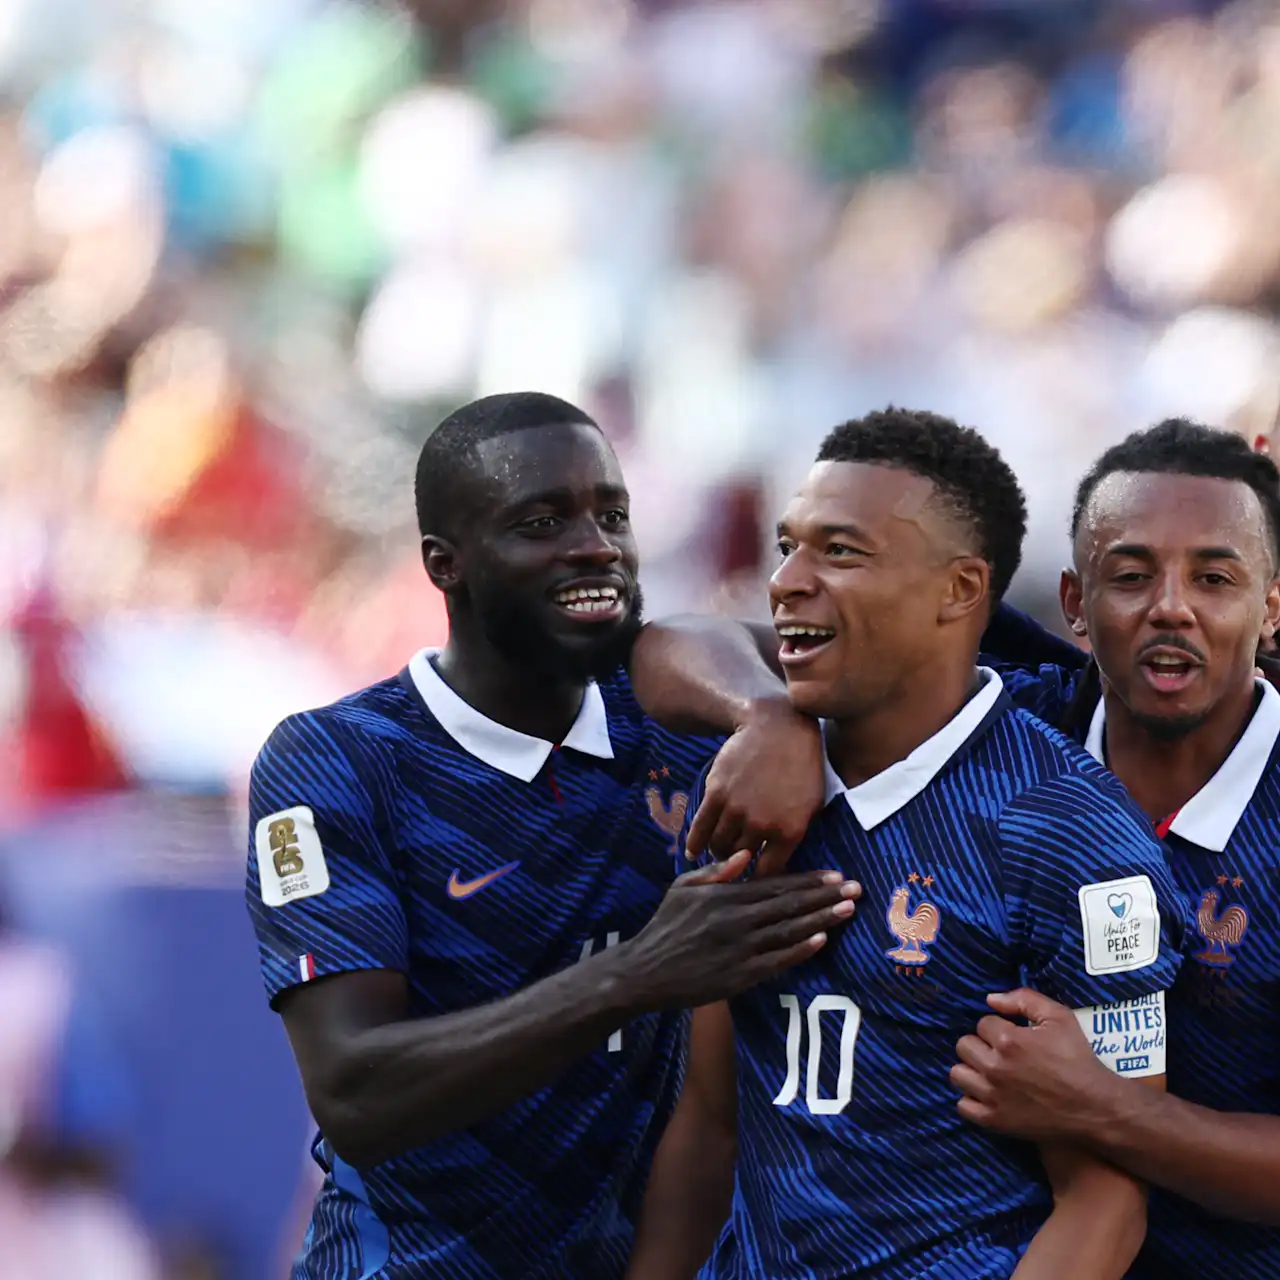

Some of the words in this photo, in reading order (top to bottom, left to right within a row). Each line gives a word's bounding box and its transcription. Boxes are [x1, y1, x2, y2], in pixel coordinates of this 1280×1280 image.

[281, 881, 309, 896] 2026
[1103, 921, 1127, 938] Unite
[1129, 918, 1141, 933] For
[1107, 934, 1140, 953] PEACE
[1115, 952, 1134, 961] FIFA
[1092, 1006, 1163, 1035] UNITES
[1091, 1037, 1120, 1056] the
[1123, 1029, 1165, 1053] World
[772, 994, 861, 1115] 10
[1118, 1058, 1148, 1071] FIFA
